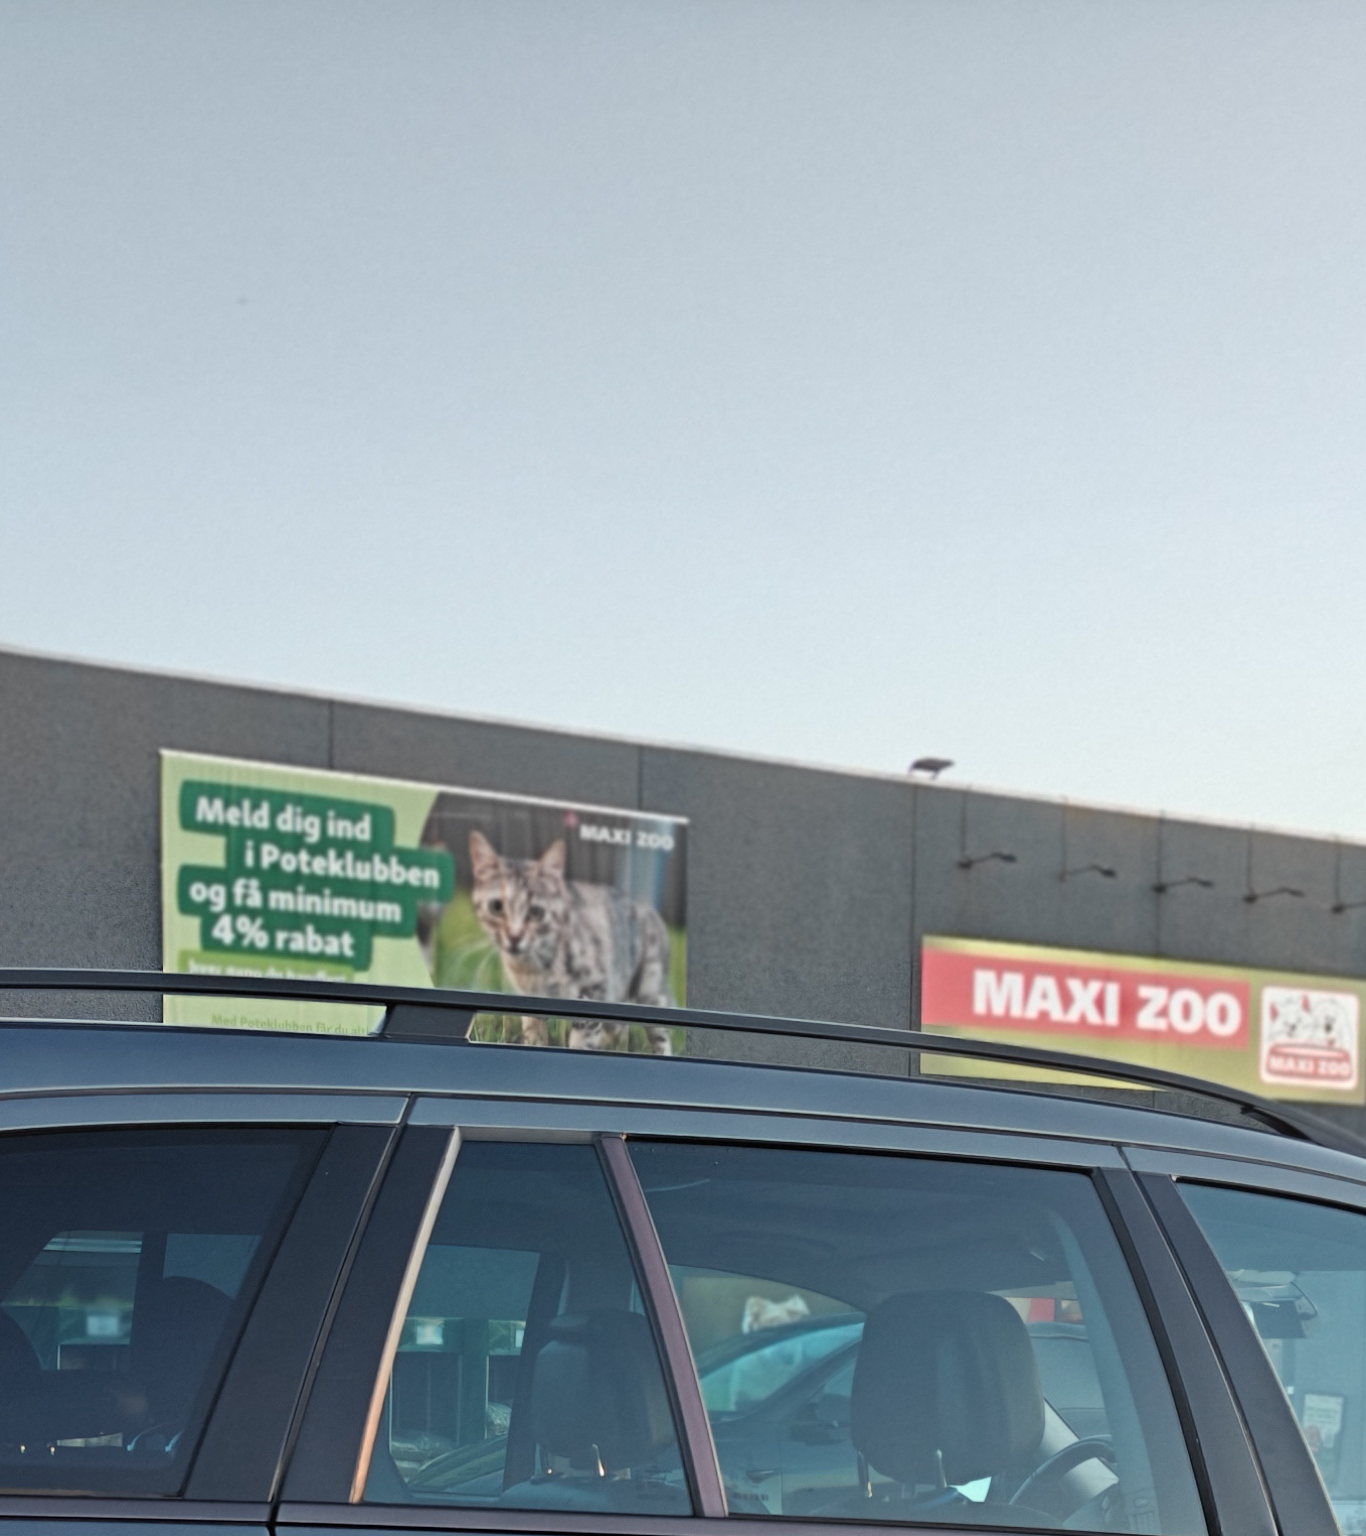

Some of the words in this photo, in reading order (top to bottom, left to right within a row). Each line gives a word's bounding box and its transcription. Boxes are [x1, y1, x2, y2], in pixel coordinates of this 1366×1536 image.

[196, 796, 269, 829] Meld
[275, 804, 321, 843] dig
[327, 811, 371, 841] ind
[579, 823, 632, 845] MAXI
[636, 830, 675, 851] ZOO
[244, 840, 254, 868] i
[260, 843, 440, 888] Poteklubben
[189, 881, 227, 912] og
[232, 877, 263, 909] få
[268, 885, 402, 923] minimum
[211, 914, 269, 949] 4%
[276, 924, 354, 957] rabat
[211, 1013, 237, 1027] Med
[973, 969, 1121, 1026] MAXI
[1137, 985, 1242, 1037] ZOO
[1269, 1056, 1315, 1074] MAXI
[1318, 1060, 1350, 1077] ZOO
